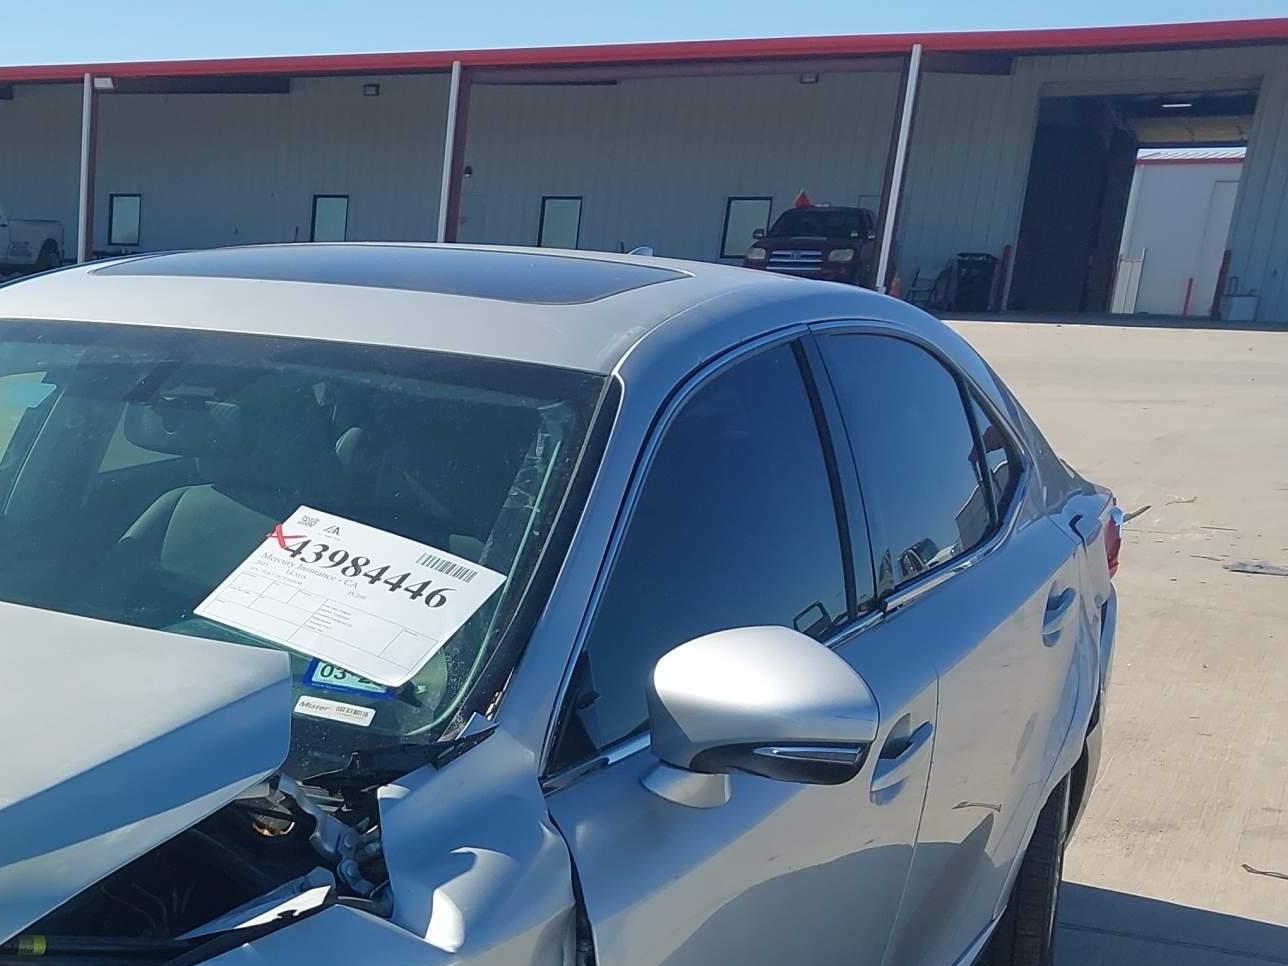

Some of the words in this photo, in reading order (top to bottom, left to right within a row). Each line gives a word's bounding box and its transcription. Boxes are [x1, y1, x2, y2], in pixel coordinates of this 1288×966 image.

[261, 552, 296, 567] Mercury
[296, 563, 337, 581] Insurance
[283, 538, 456, 609] 43984446
